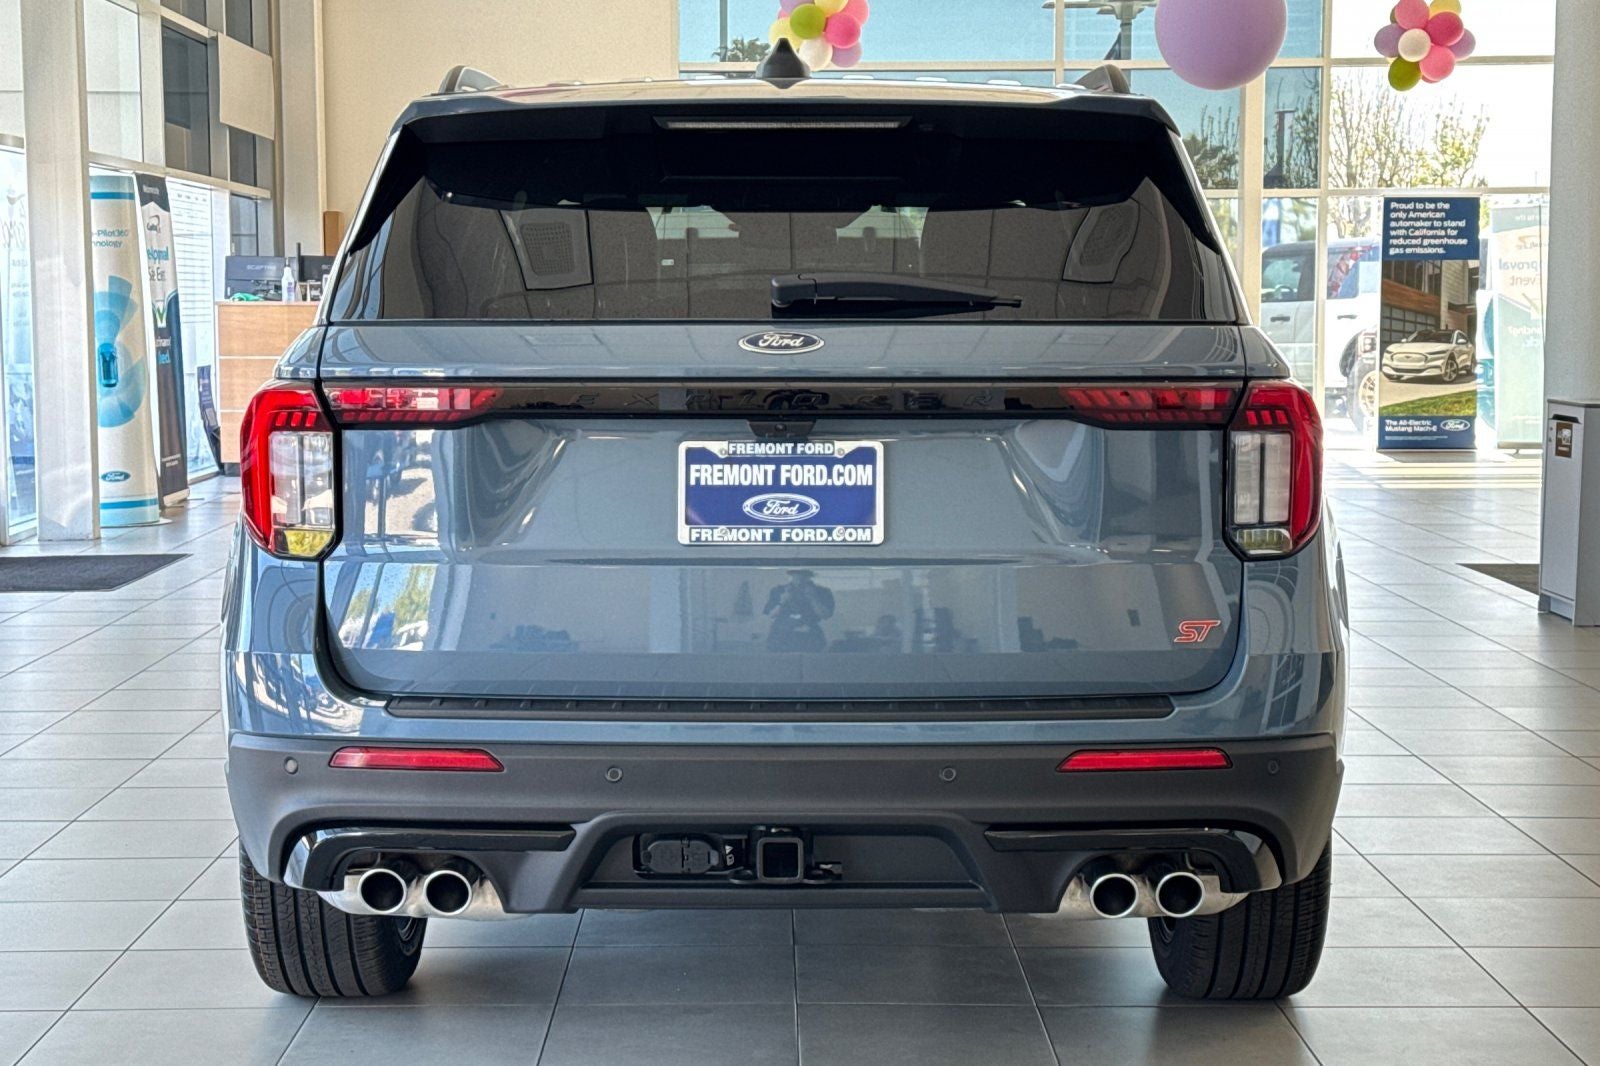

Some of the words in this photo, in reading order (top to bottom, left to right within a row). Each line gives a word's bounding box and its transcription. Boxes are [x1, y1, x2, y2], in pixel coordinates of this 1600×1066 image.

[1390, 202, 1414, 210] Proud
[1425, 202, 1435, 210] be
[1436, 202, 1450, 210] the
[1390, 211, 1407, 219] only
[1408, 211, 1446, 219] American
[1390, 220, 1432, 228] automaker
[1444, 219, 1466, 227] stand
[1409, 228, 1446, 236] California
[1447, 228, 1459, 236] for
[1423, 237, 1468, 247] greenhouse
[758, 334, 804, 347] Ford
[1385, 425, 1413, 433] Mustang
[729, 443, 795, 454] FREMONT
[797, 443, 834, 454] FORD
[690, 464, 775, 486] FREMONT
[780, 464, 873, 486] FORD.COM
[763, 500, 799, 515] Ford
[691, 529, 773, 542] FREMONT
[781, 528, 871, 542] FORD.COM
[1173, 620, 1221, 642] ST
